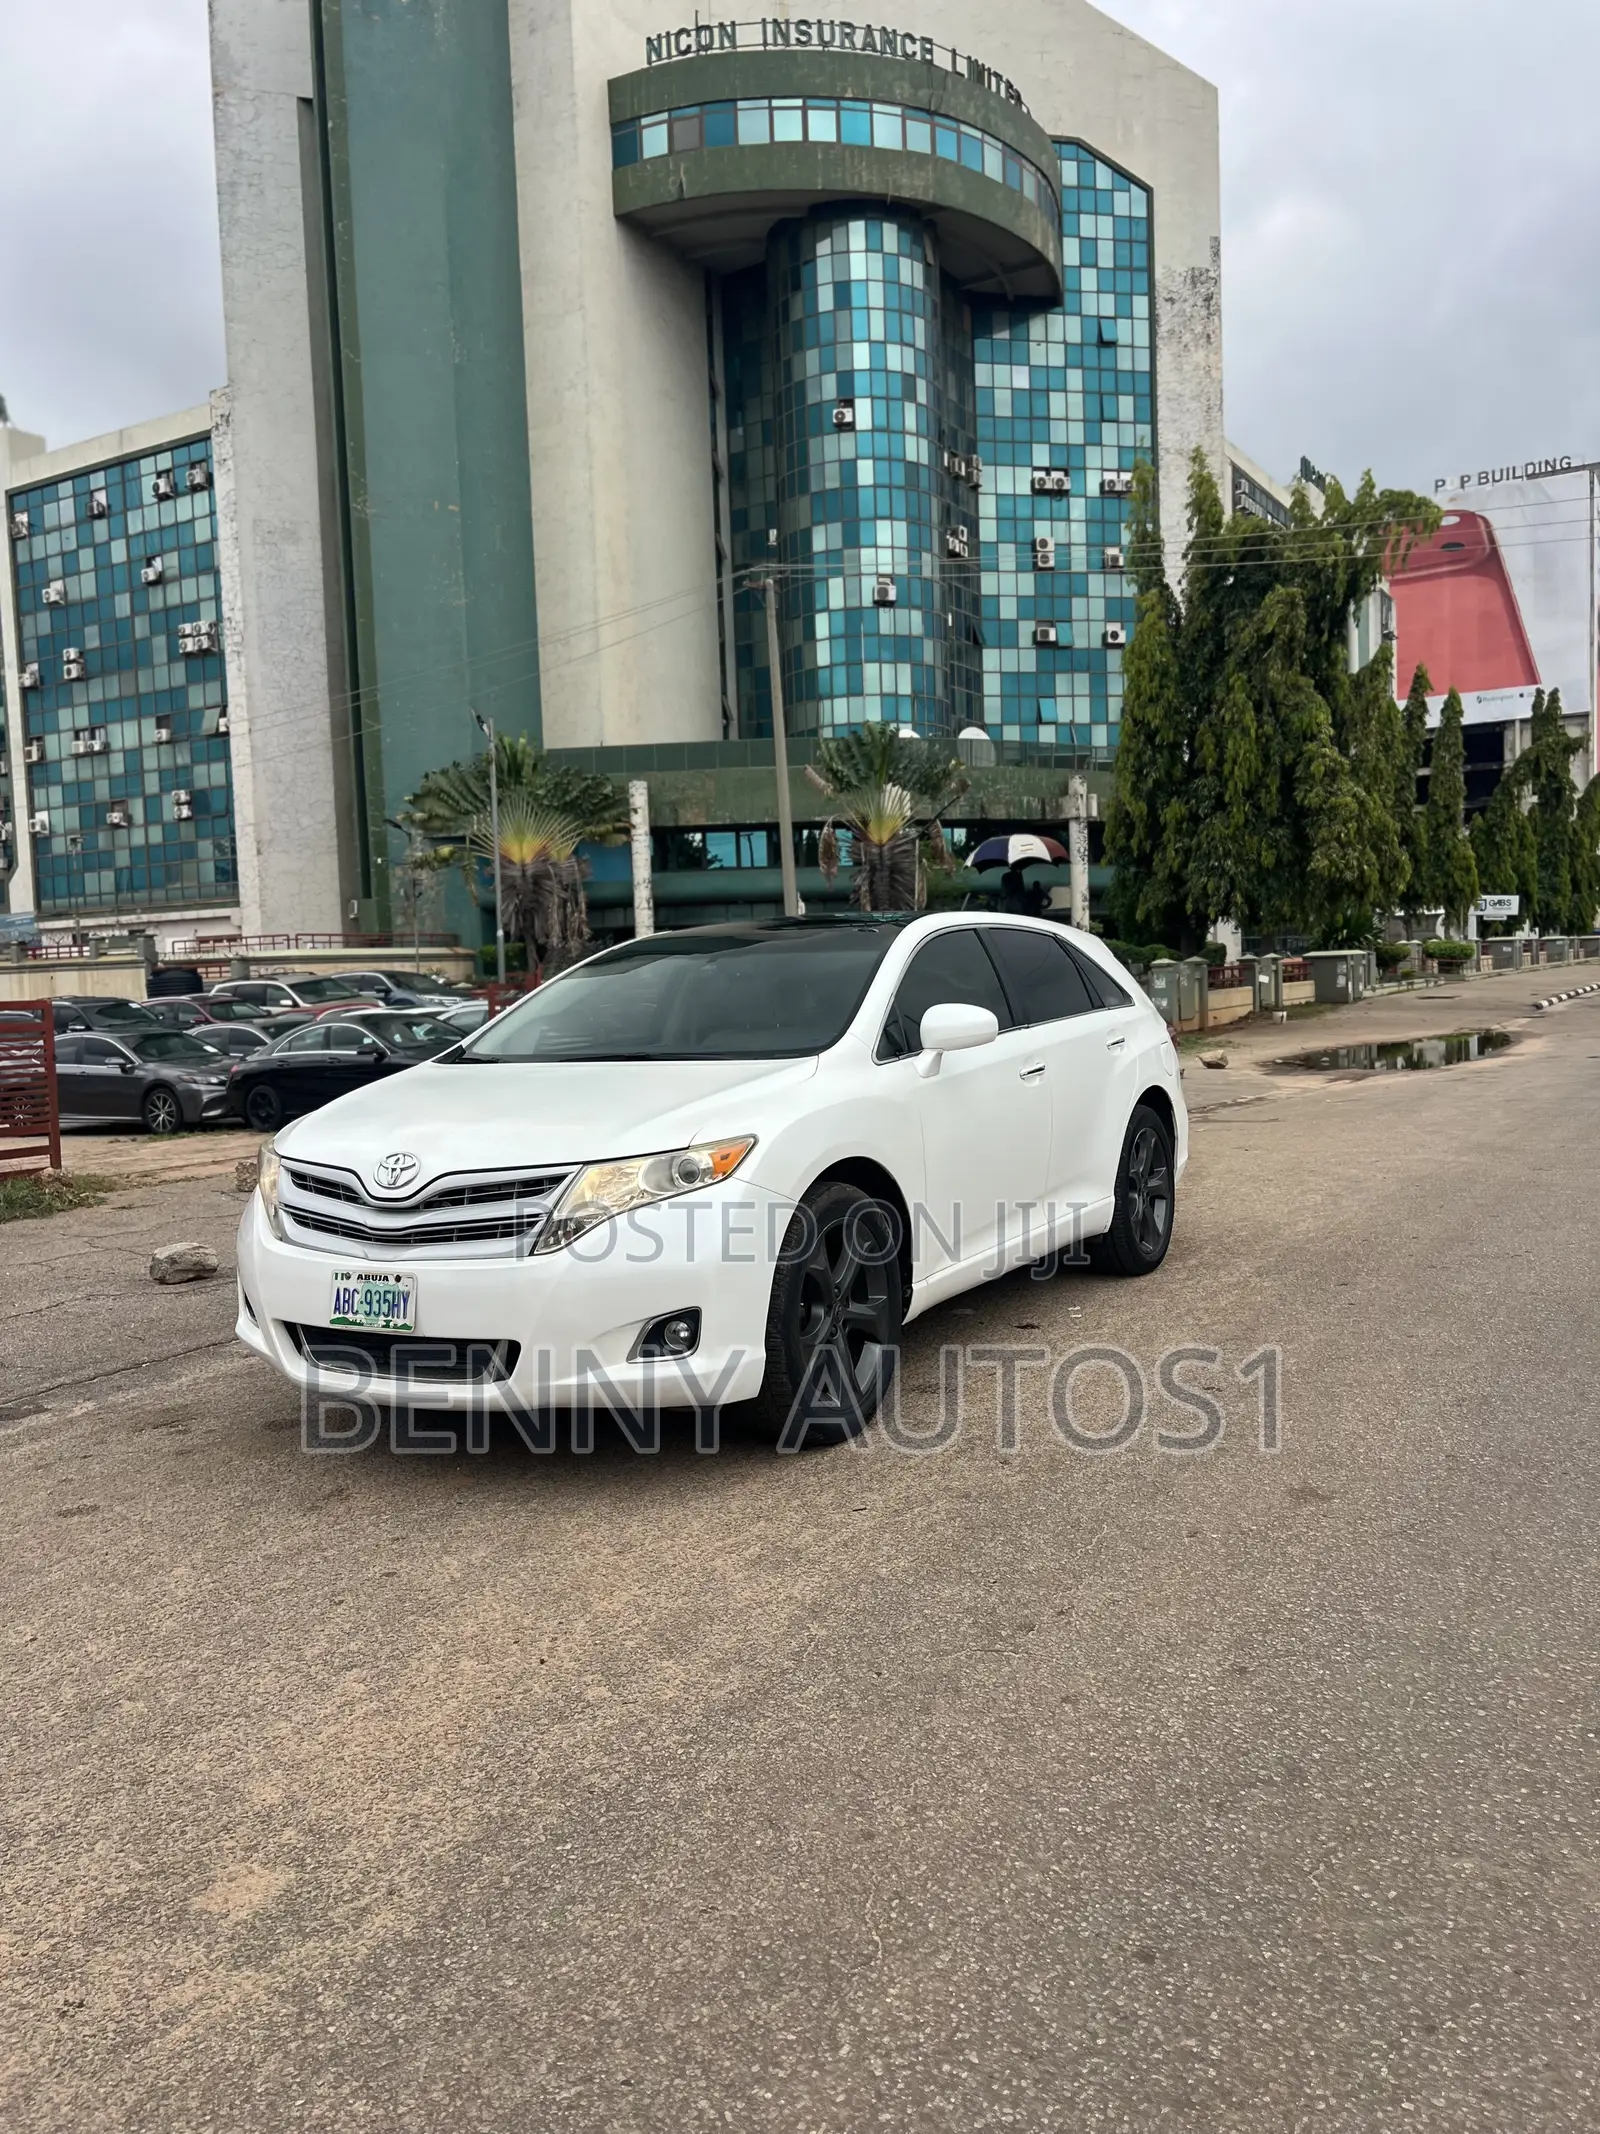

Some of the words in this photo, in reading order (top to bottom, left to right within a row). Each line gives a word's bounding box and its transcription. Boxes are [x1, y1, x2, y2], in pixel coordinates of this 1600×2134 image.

[646, 20, 737, 65] NICON
[761, 18, 934, 64] INSURANCE
[1477, 456, 1571, 486] BUILDING
[357, 1274, 389, 1282] ABUJA
